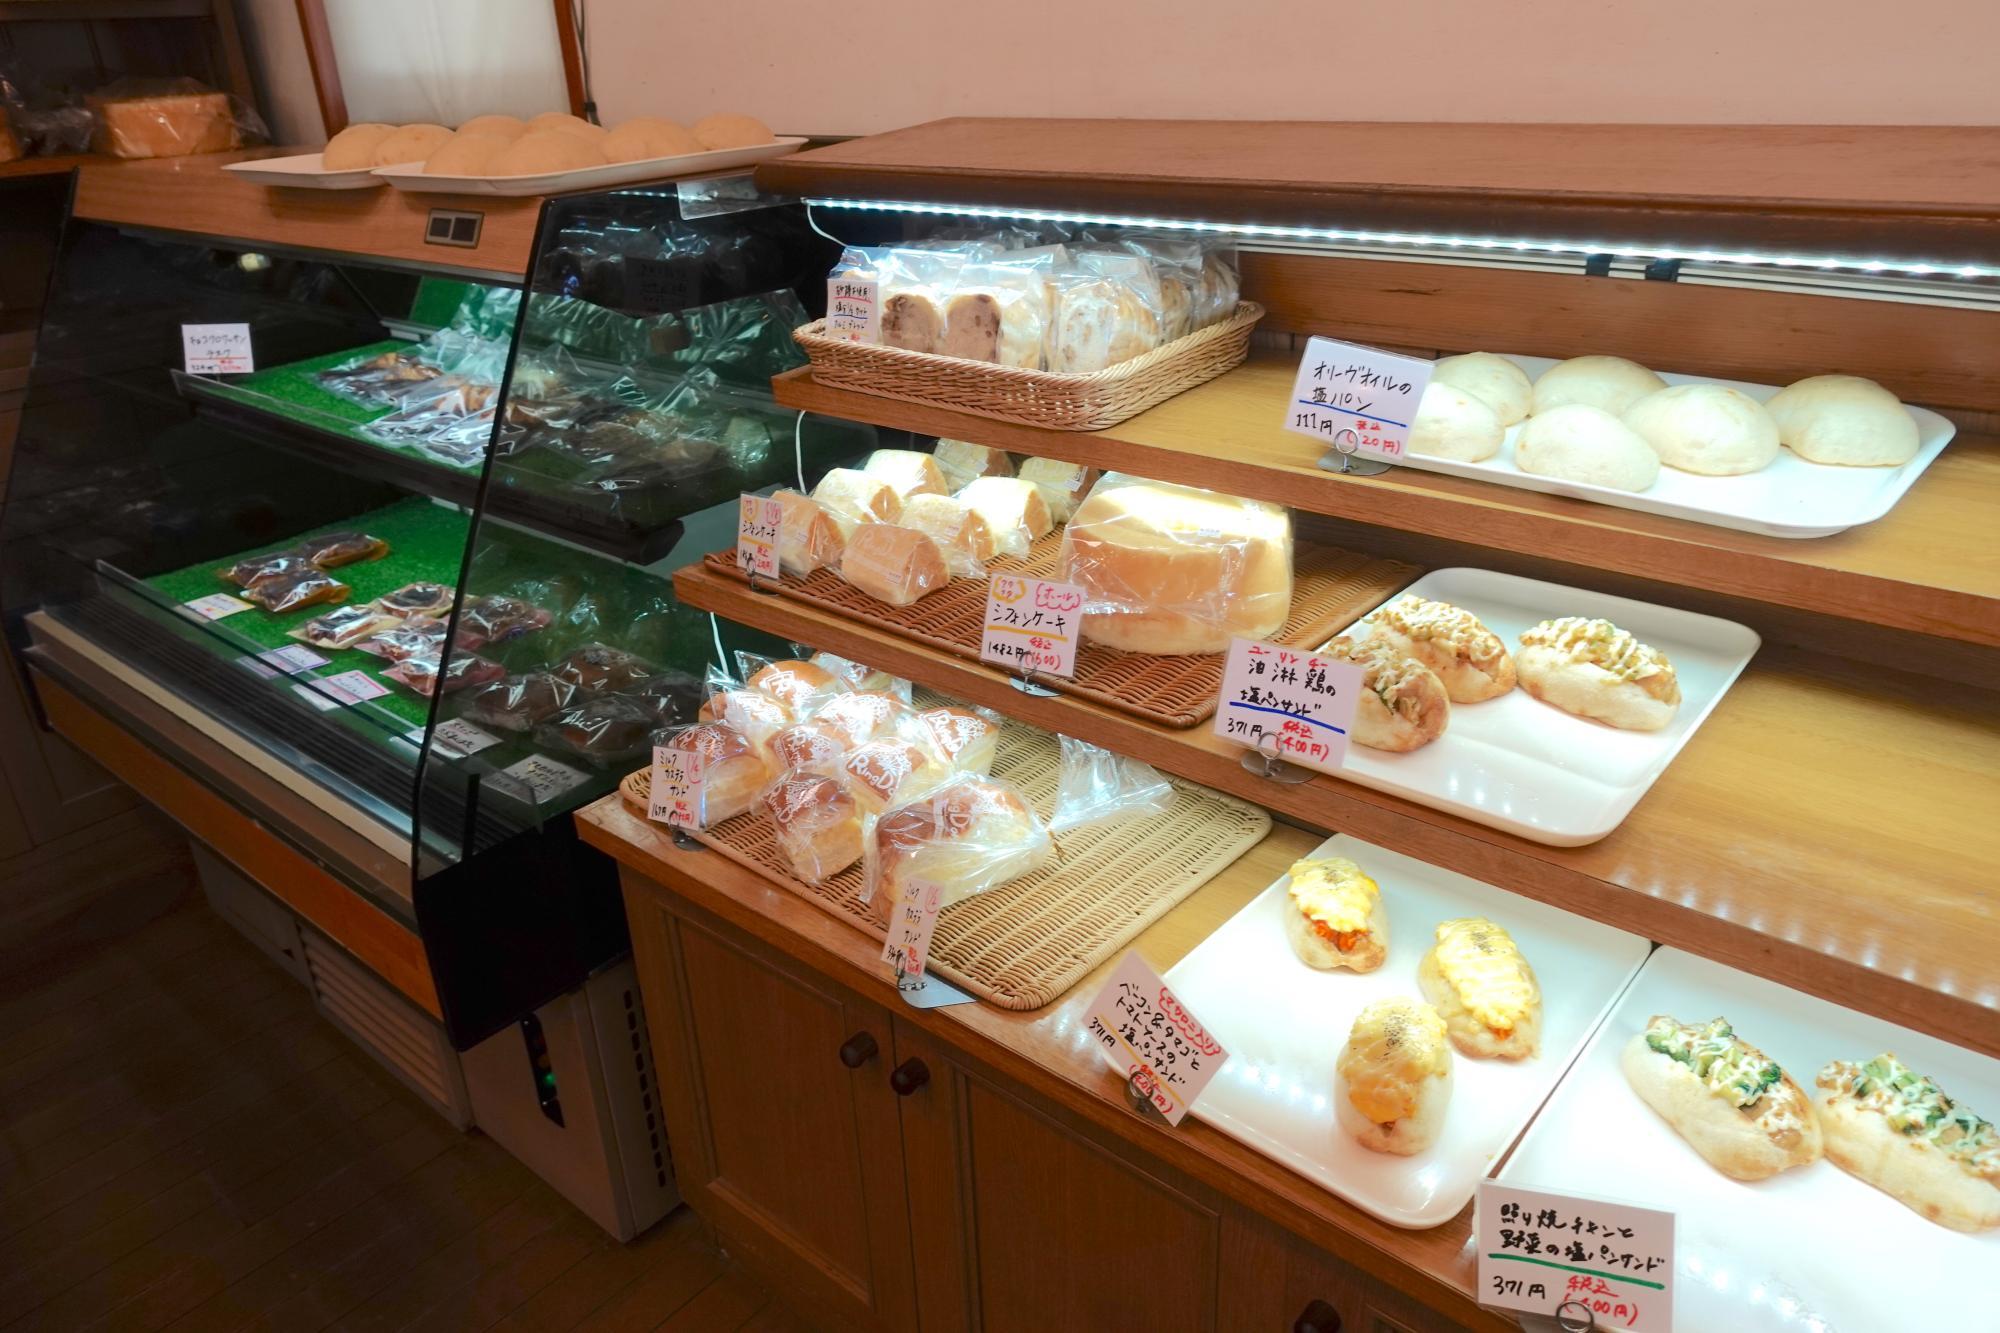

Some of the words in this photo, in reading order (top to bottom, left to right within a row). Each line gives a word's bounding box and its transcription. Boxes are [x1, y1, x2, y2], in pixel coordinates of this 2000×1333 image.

[1313, 361, 1412, 395] オリーヴオイルの
[1312, 386, 1373, 412] 塩パン
[1296, 413, 1333, 436] 111円
[993, 603, 1066, 636] シフォンケーキ
[1248, 658, 1336, 697] 油淋鶏の
[1227, 718, 1263, 738] 371円
[1088, 1016, 1117, 1048] 371円
[1493, 1276, 1546, 1300] 371円
